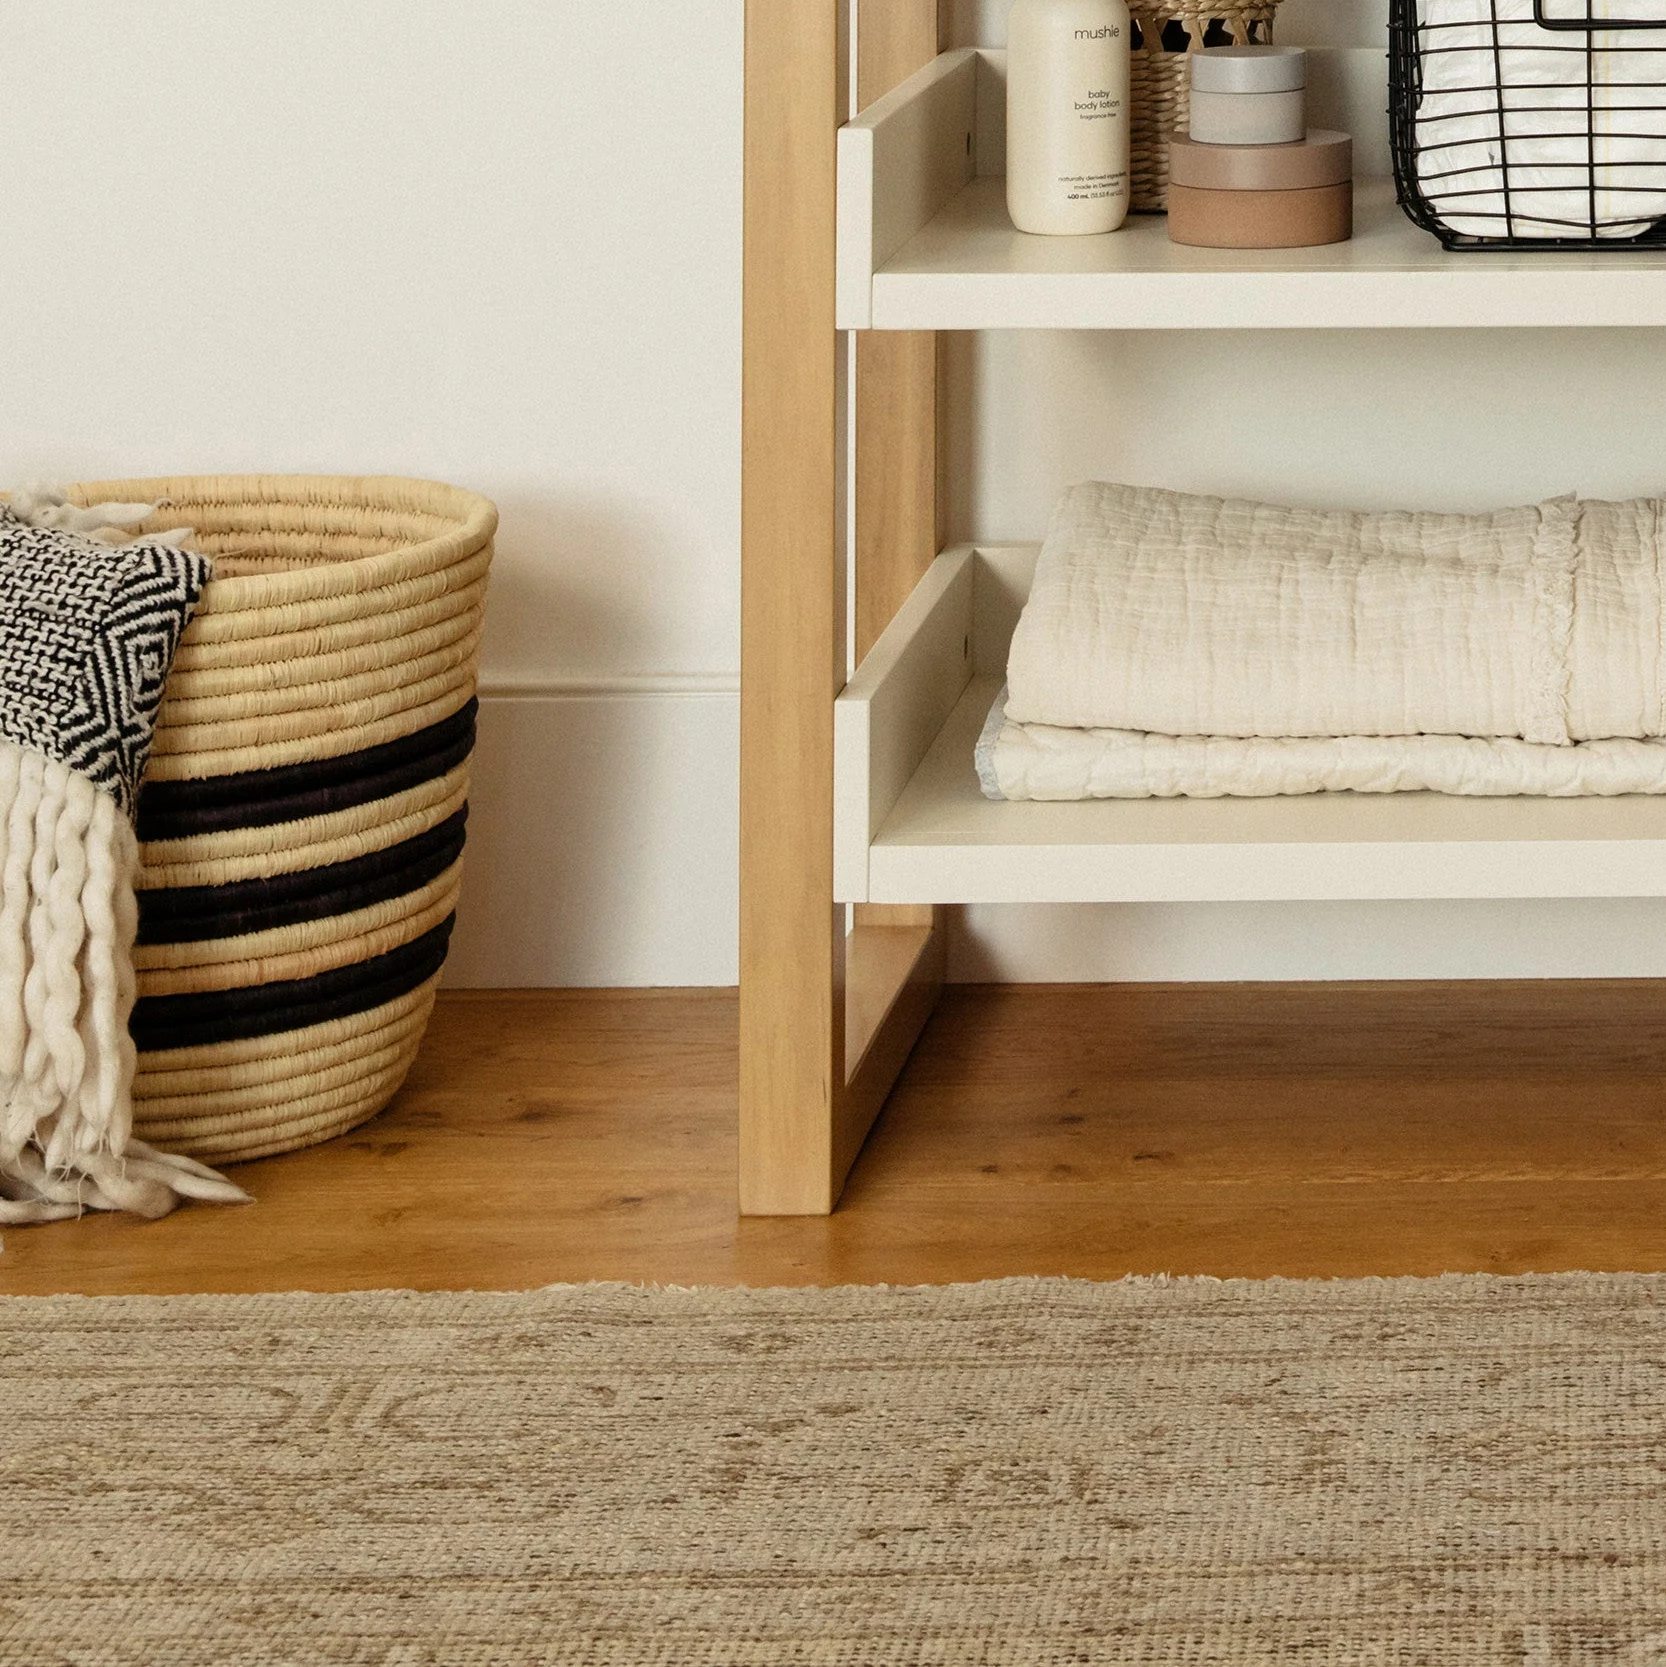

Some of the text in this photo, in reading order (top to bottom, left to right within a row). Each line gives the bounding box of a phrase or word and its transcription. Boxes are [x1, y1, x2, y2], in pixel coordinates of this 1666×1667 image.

[1074, 25, 1119, 39] mushie
[1088, 90, 1110, 99] baby
[1074, 100, 1120, 110] body lotion
